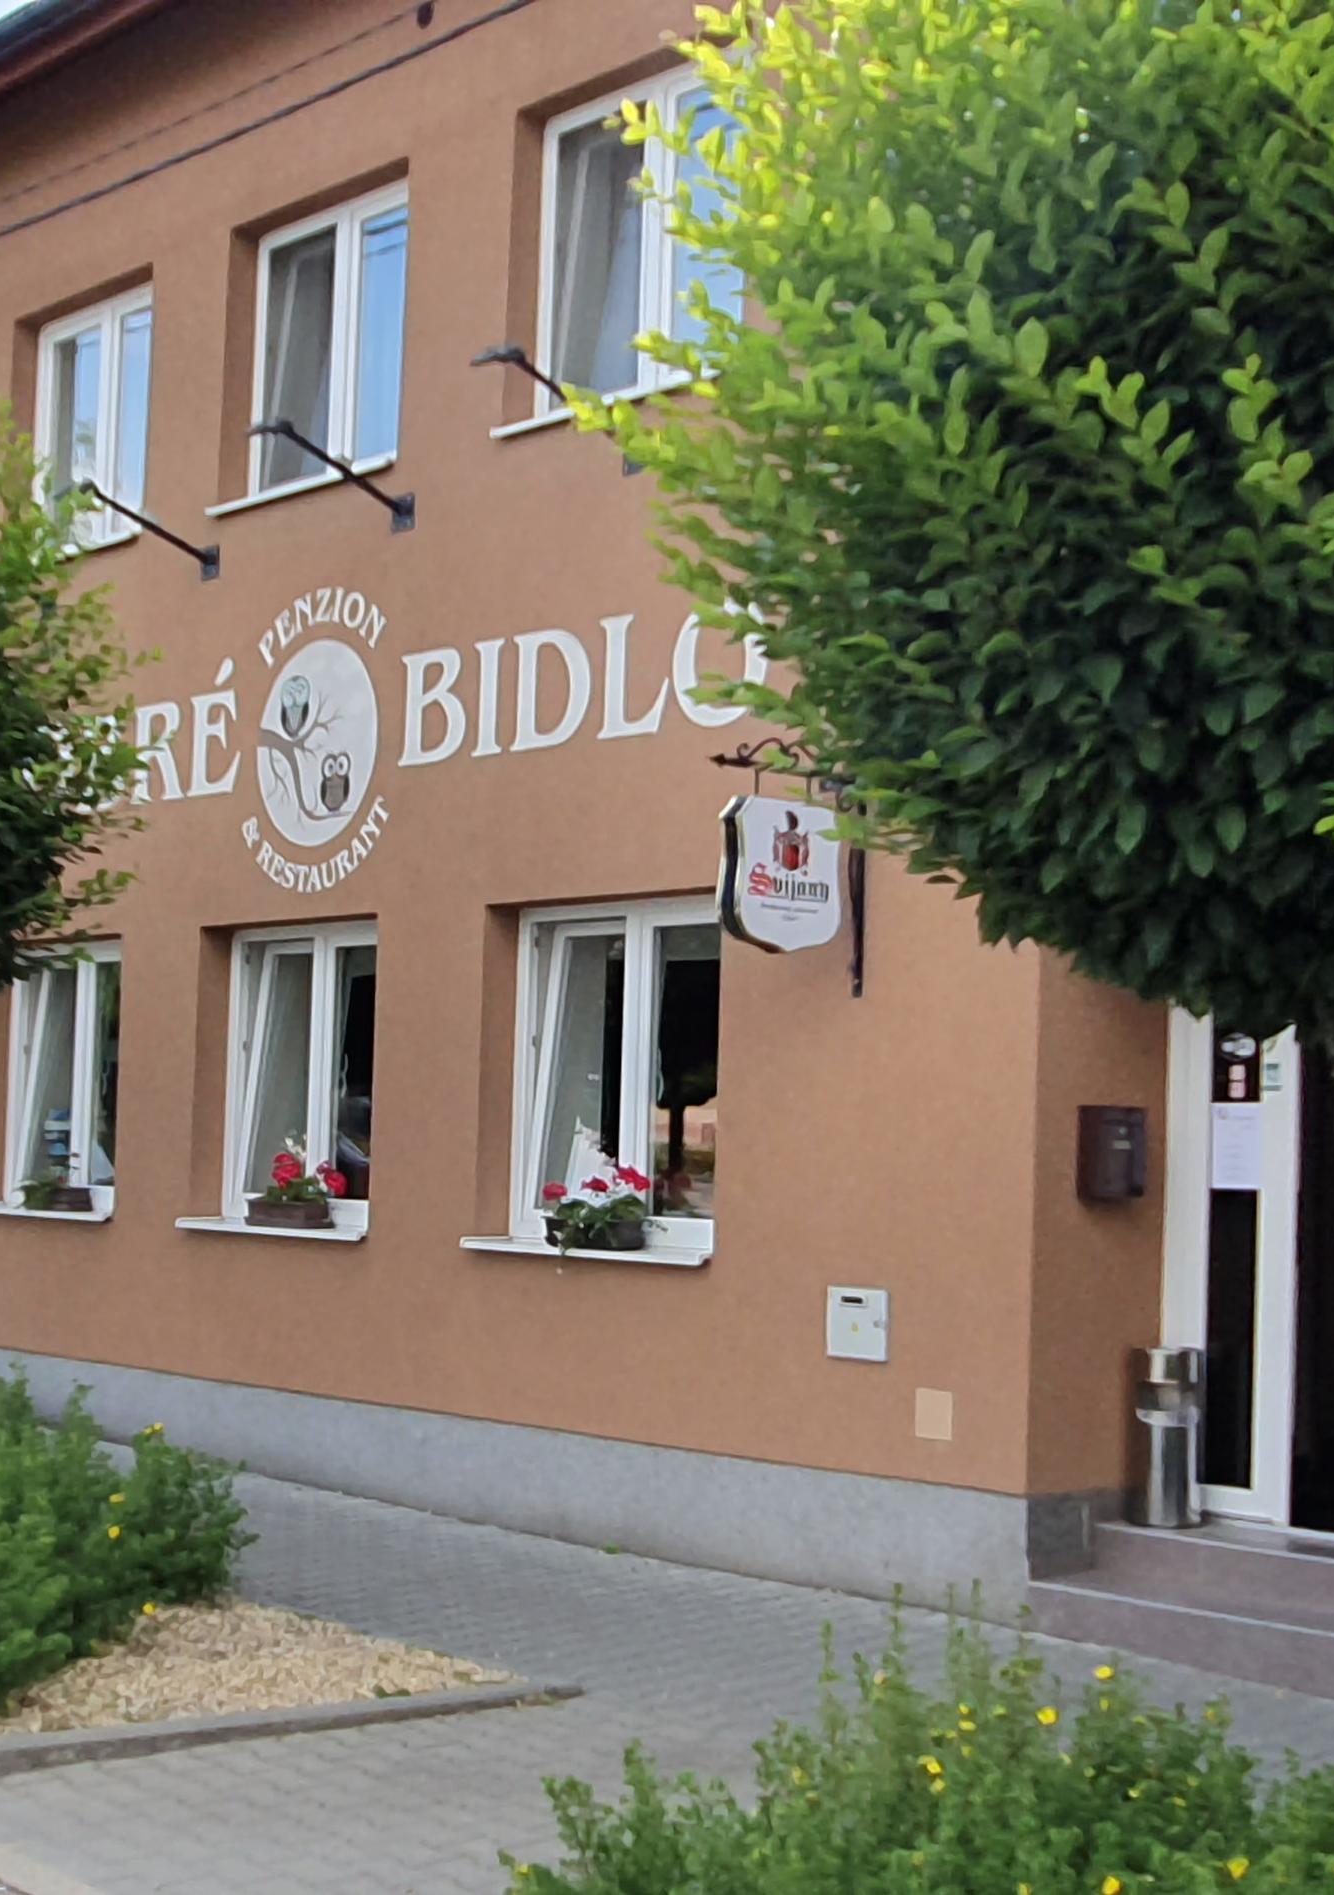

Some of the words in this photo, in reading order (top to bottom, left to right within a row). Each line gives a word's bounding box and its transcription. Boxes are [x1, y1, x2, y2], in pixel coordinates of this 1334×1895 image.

[258, 586, 387, 669] PENZION
[398, 597, 768, 768] BIDLO
[242, 816, 260, 849] &
[255, 795, 390, 893] RESTAURANT
